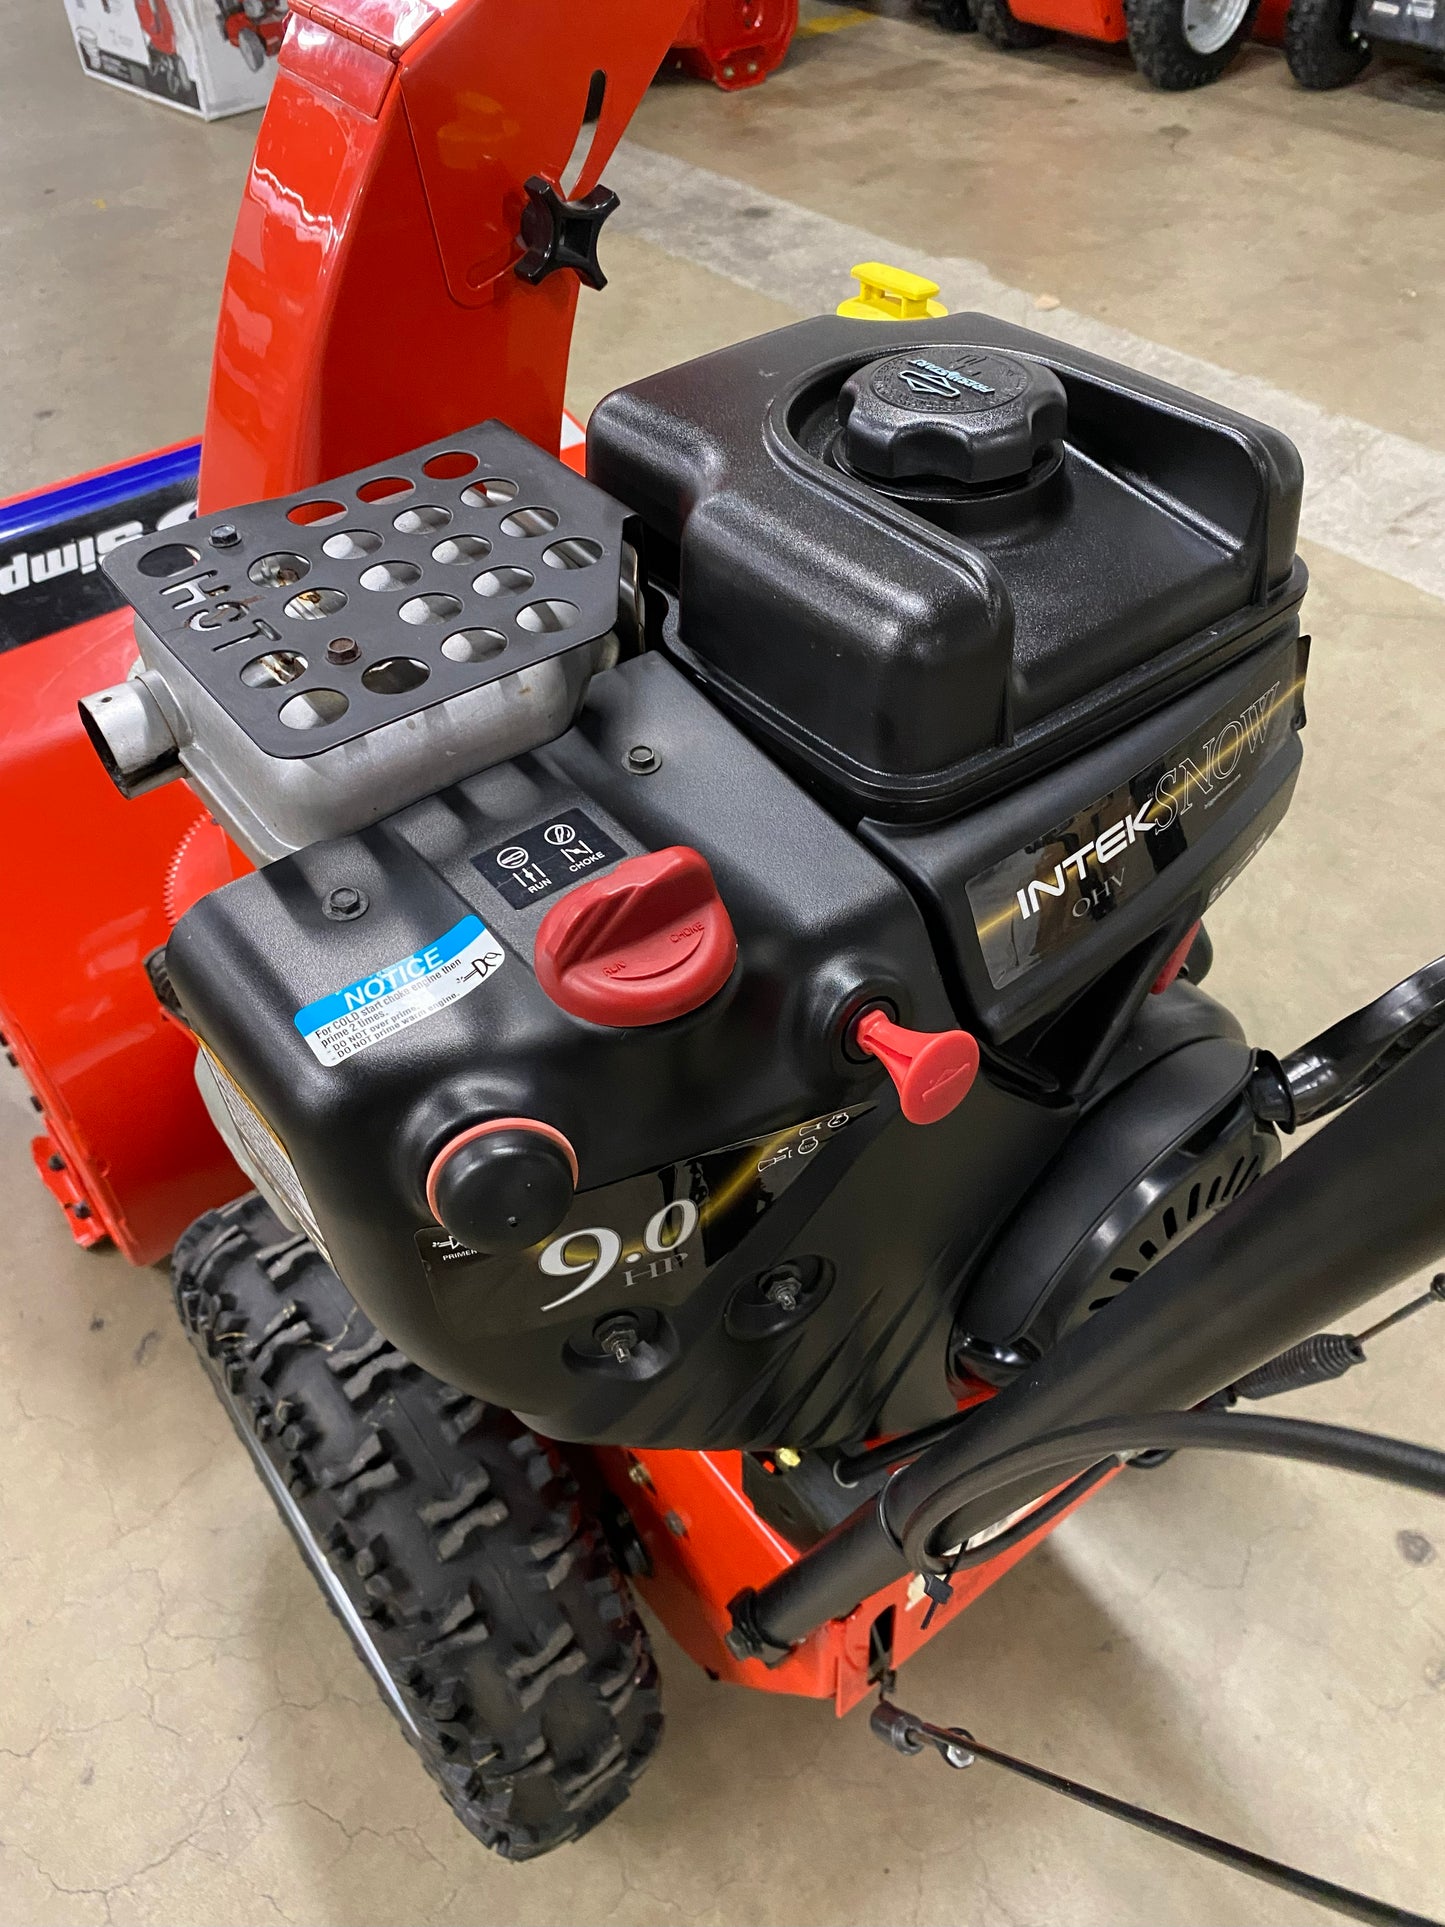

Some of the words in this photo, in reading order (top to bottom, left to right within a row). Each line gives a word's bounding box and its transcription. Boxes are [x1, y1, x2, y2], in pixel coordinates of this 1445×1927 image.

[159, 569, 283, 653] HOT
[1017, 798, 1156, 920] INTEK
[1154, 681, 1280, 836] SNOW
[569, 851, 605, 872] CHOKE
[528, 878, 552, 894] RUN
[1072, 867, 1125, 918] OHV
[669, 921, 705, 943] CHOKE
[344, 946, 444, 1011] NOTICE
[603, 961, 626, 976] RUN
[315, 1026, 332, 1039] For
[333, 1011, 360, 1030] COLD
[361, 1000, 384, 1017] start
[383, 986, 410, 1005] choke
[411, 972, 442, 992] engine
[441, 959, 461, 974] then
[321, 1029, 349, 1048] prime
[349, 1022, 358, 1032] 2
[358, 1009, 389, 1027] times.
[333, 1040, 347, 1051] DO
[349, 1029, 368, 1043] NOT
[370, 1019, 389, 1032] over
[337, 1046, 352, 1058] DO
[353, 1035, 373, 1049] NOT
[374, 1023, 400, 1040] prime
[401, 1010, 426, 1025] warm
[428, 993, 461, 1012] engine.
[538, 1199, 699, 1312] 9.0
[623, 1252, 688, 1287] HP
